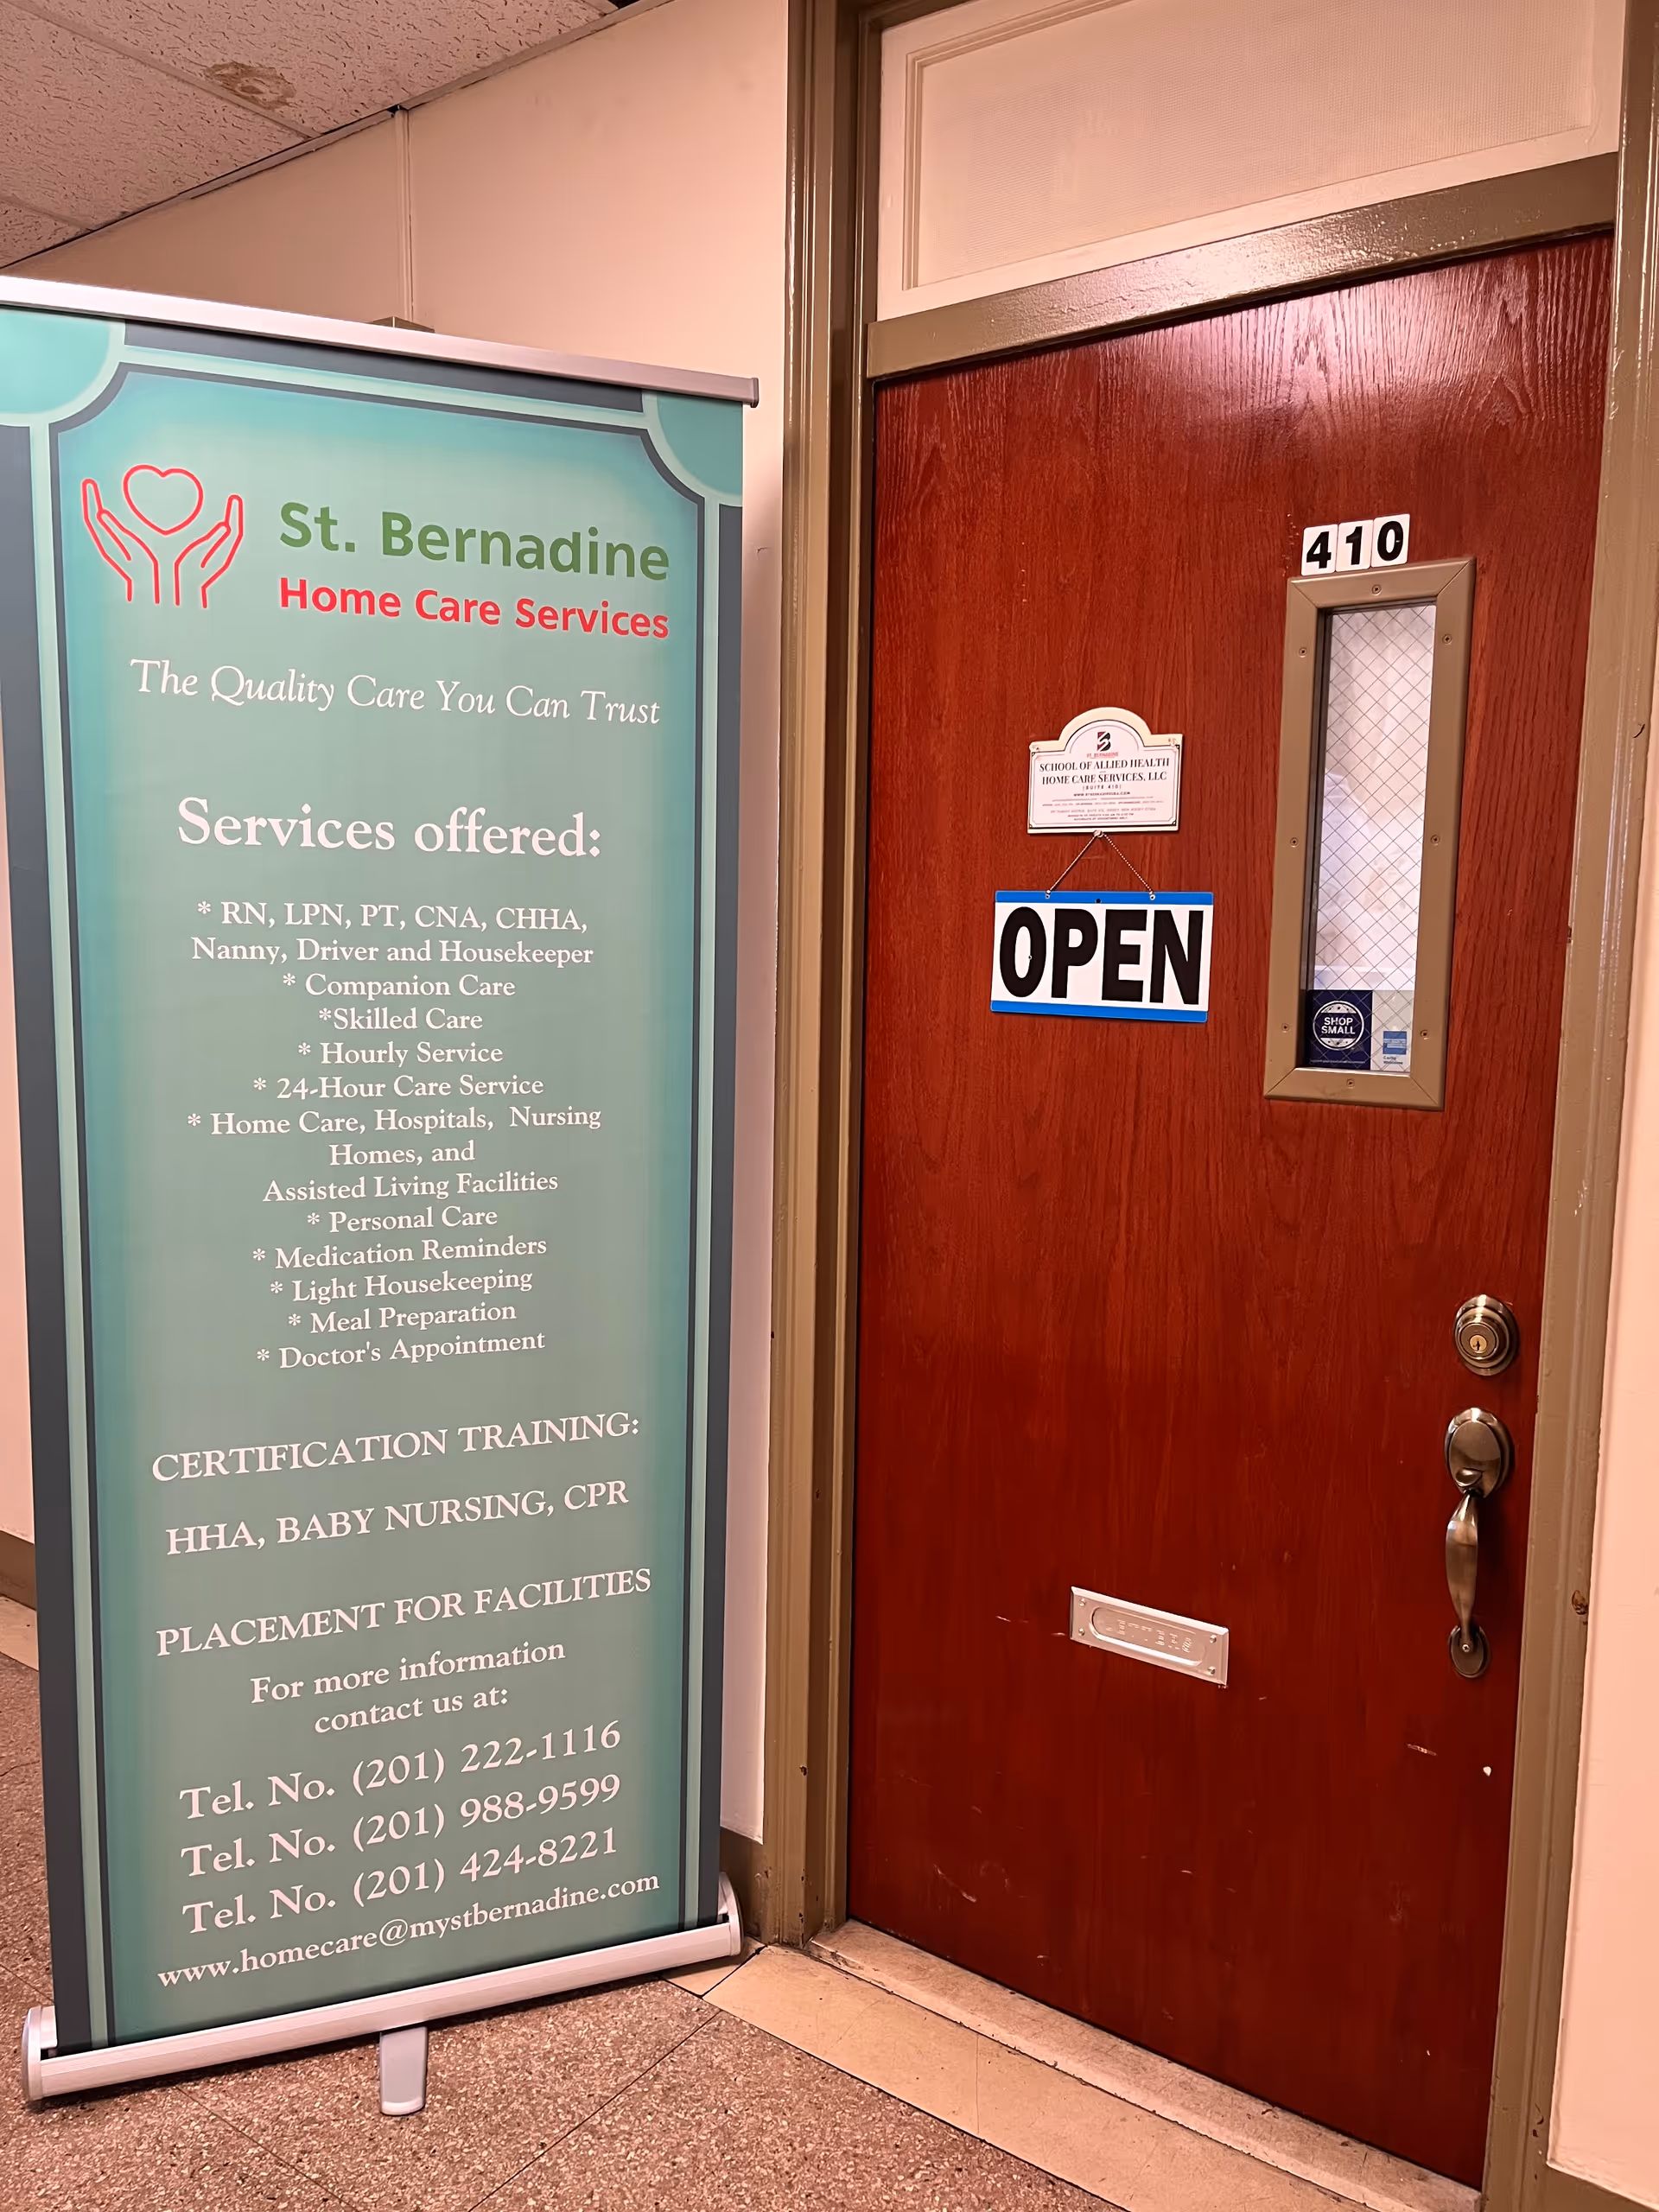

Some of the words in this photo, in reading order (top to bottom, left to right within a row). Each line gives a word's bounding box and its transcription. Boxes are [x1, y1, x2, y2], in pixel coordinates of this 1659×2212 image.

[279, 501, 356, 553] St.
[382, 511, 670, 581] Bernadine
[1306, 520, 1404, 569] 410
[278, 576, 403, 620] Home
[414, 588, 502, 627] Care
[514, 596, 670, 640] Services
[130, 658, 198, 696] The
[211, 665, 335, 712] Quality
[347, 674, 425, 710] Care
[435, 680, 496, 715] You
[505, 684, 570, 719] Can
[580, 690, 661, 724] Trust
[1039, 762, 1077, 772] SCHOOL
[1079, 761, 1092, 771] OF
[1094, 760, 1128, 770] ALLIED
[1130, 757, 1170, 768] HEALTH
[1042, 775, 1070, 785] HOME
[1071, 773, 1096, 784] CARE
[1097, 772, 1147, 783] SERVICES,
[1147, 771, 1167, 781] LLC
[178, 797, 396, 850] Services
[414, 806, 601, 858] offered:
[219, 901, 276, 929] RN,
[283, 902, 352, 930] LPN,
[359, 904, 406, 931] PT,
[415, 905, 487, 932] CNA,
[495, 906, 588, 934] CHHA,
[190, 937, 288, 965] Nanny,
[296, 938, 379, 961] Driver
[386, 938, 433, 962] and
[438, 939, 594, 969] Housekeeper
[999, 906, 1205, 1005] OPEN
[305, 972, 452, 1001] Companion
[458, 974, 516, 996] Care
[425, 1007, 483, 1030] Care
[1320, 1025, 1357, 1035] SMALL
[1324, 1016, 1354, 1027] SHOP
[319, 1040, 409, 1068] Hourly
[416, 1040, 504, 1063] Service
[276, 1076, 386, 1101] 24-Hour
[393, 1074, 452, 1097] Care
[459, 1074, 544, 1096] Service
[209, 1112, 291, 1135] Home
[298, 1110, 366, 1135] Care,
[373, 1106, 494, 1135] Hospitals,
[508, 1105, 601, 1129] Nursing
[328, 1143, 423, 1166] Homes,
[431, 1139, 476, 1162] and
[262, 1175, 366, 1202] Assisted
[372, 1175, 449, 1200] Living
[455, 1170, 558, 1194] Facilities
[328, 1205, 435, 1233] Personal
[441, 1205, 499, 1227] Care
[274, 1243, 415, 1269] Medication
[421, 1234, 547, 1261] Reminders
[291, 1277, 358, 1306] Light
[363, 1268, 533, 1297] Housekeeping
[309, 1307, 372, 1334] Meal
[378, 1301, 518, 1331] Preparation
[277, 1340, 381, 1369] Doctor's
[389, 1332, 546, 1363] Appointment
[152, 1428, 448, 1482] CERTIFICATION
[457, 1411, 639, 1452] TRAINING:
[165, 1521, 265, 1555] HHA,
[276, 1507, 375, 1544] BABY
[384, 1490, 555, 1531] NURSING,
[563, 1480, 630, 1510] CPR
[156, 1602, 385, 1656] PLACEMENT
[393, 1592, 466, 1625] FOR
[473, 1567, 652, 1615] FACILITIES
[250, 1676, 305, 1704] For
[313, 1658, 391, 1696] more
[398, 1641, 566, 1681] information
[315, 1697, 423, 1733] contact
[431, 1694, 463, 1714] us
[473, 1687, 508, 1709] at:
[179, 1780, 255, 1820] Tel.
[267, 1771, 335, 1807] No.
[353, 1748, 445, 1796] (201)
[461, 1719, 620, 1773] 222-1116
[180, 1837, 256, 1877] Tel.
[268, 1828, 336, 1864] No.
[353, 1803, 445, 1853] (201)
[460, 1773, 620, 1828] 988-9599
[181, 1893, 257, 1934] Tel.
[269, 1884, 336, 1919] No.
[353, 1858, 445, 1908] (201)
[459, 1827, 617, 1883] 424-8221
[156, 1872, 660, 1987] www.homecare@mystbernadine.com
